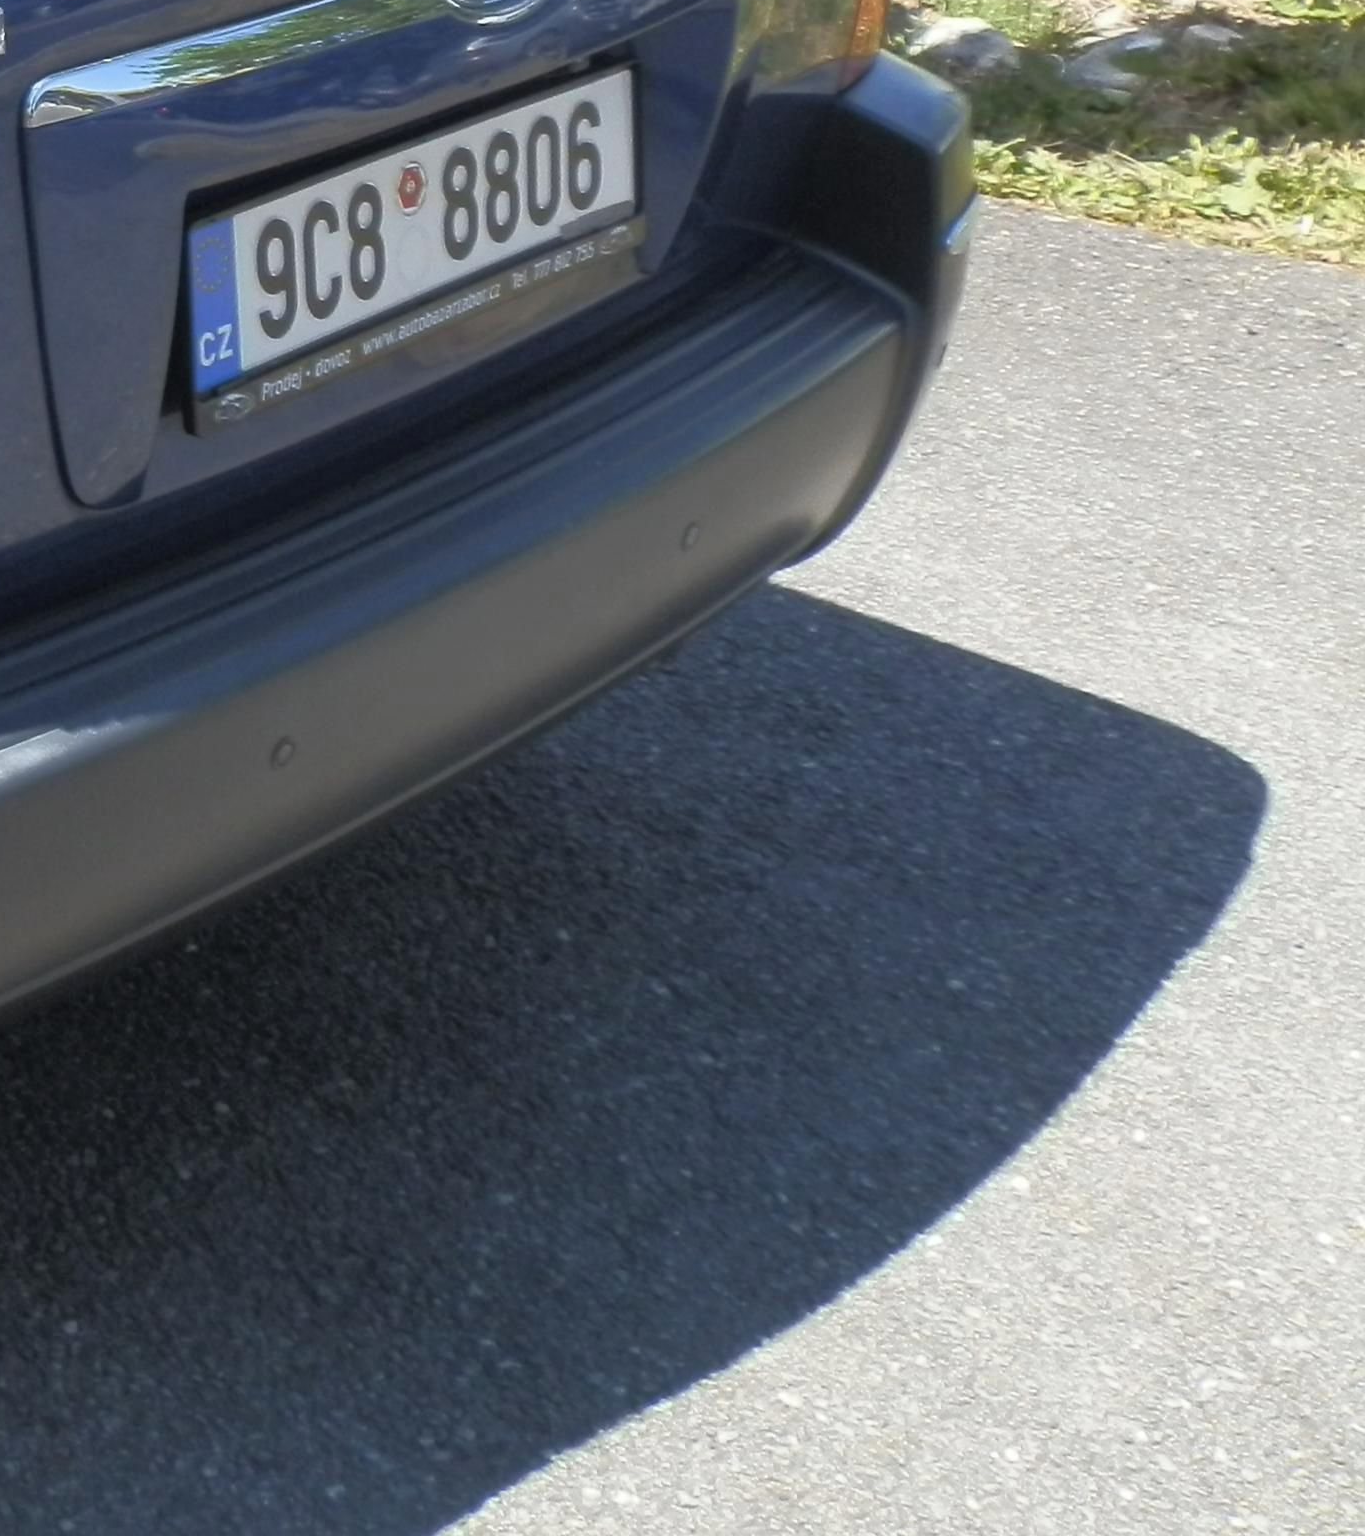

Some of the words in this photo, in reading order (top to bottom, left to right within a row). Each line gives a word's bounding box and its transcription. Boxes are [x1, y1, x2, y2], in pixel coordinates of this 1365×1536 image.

[256, 181, 386, 340] 9C8
[441, 100, 603, 261] 8806
[199, 324, 234, 367] CZ
[261, 366, 303, 401] Prodej
[315, 349, 352, 377] dovoz
